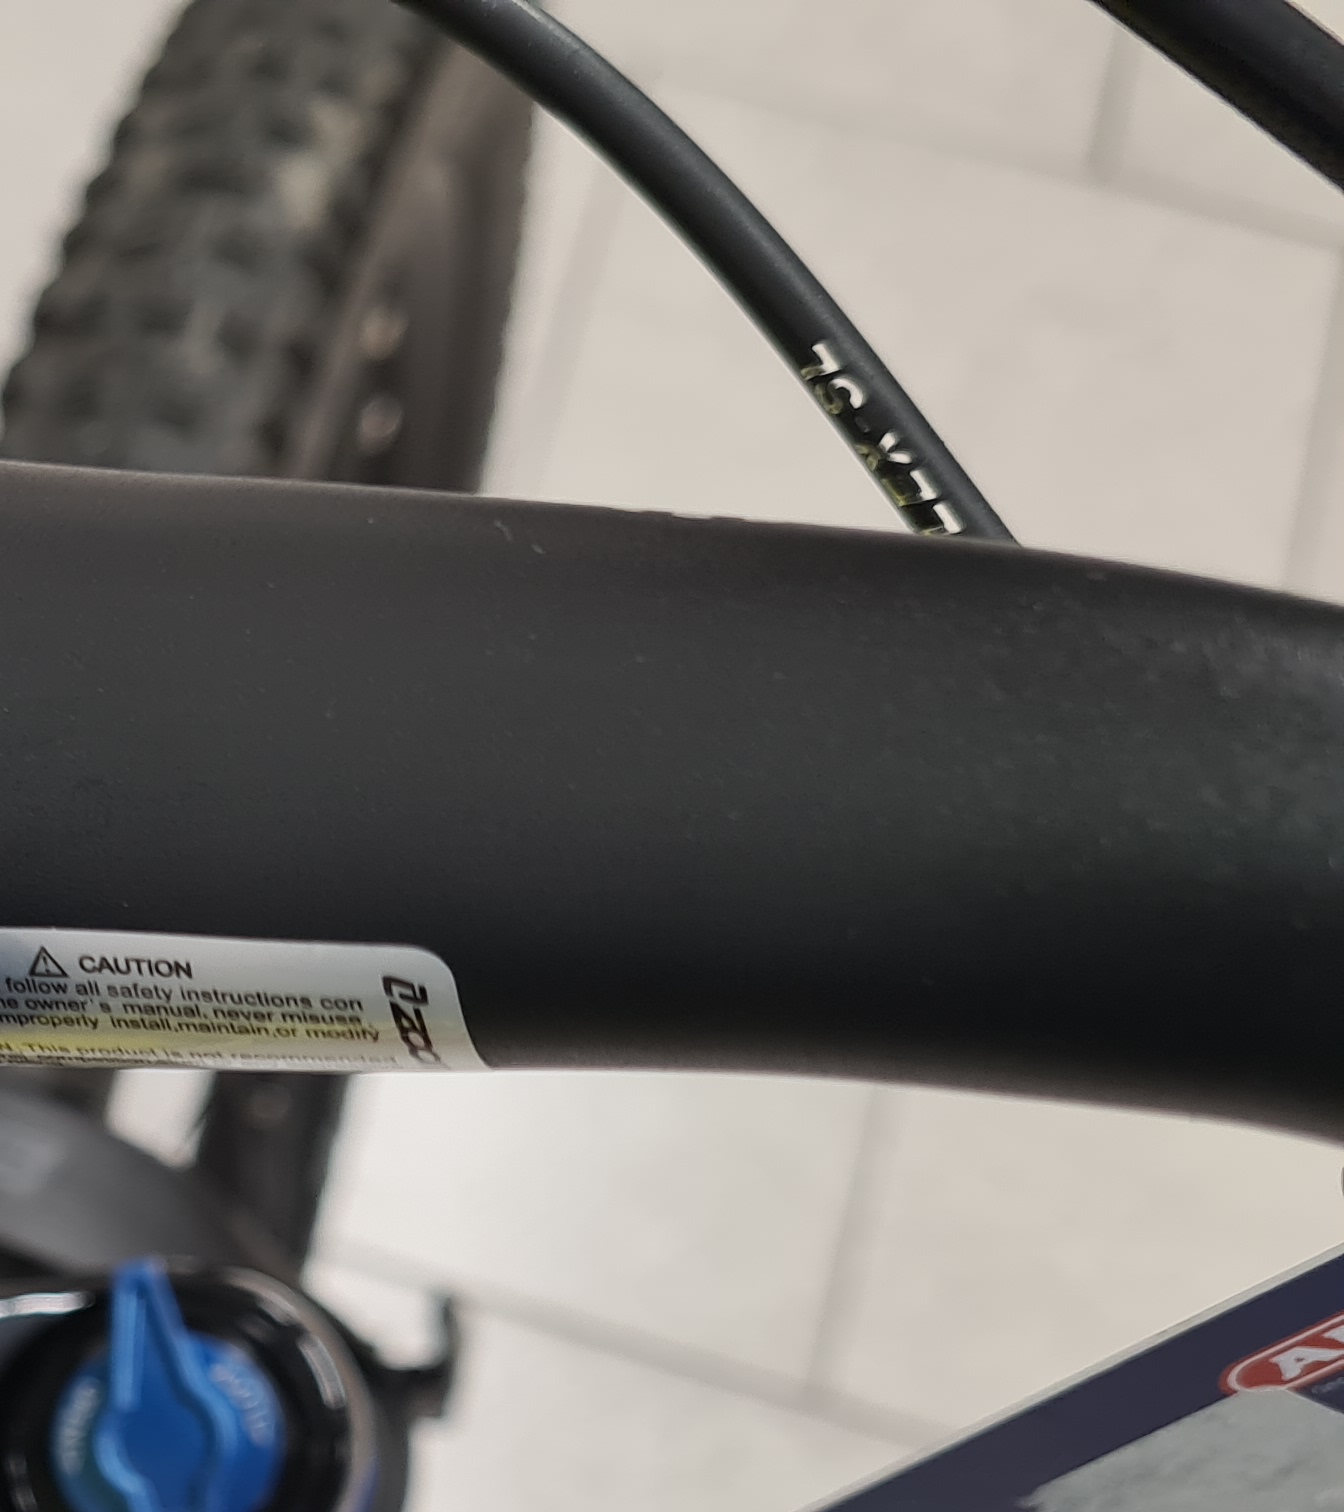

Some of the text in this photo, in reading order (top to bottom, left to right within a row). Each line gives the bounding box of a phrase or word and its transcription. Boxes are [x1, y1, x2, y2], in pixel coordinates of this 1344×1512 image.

[78, 955, 193, 979] CAUTION
[5, 977, 68, 995] follow
[75, 979, 100, 996] all
[107, 982, 172, 1003] safety
[180, 986, 312, 1009] instructions
[213, 1006, 273, 1023] never
[305, 1027, 380, 1043] modify
[1268, 1324, 1344, 1382] A
